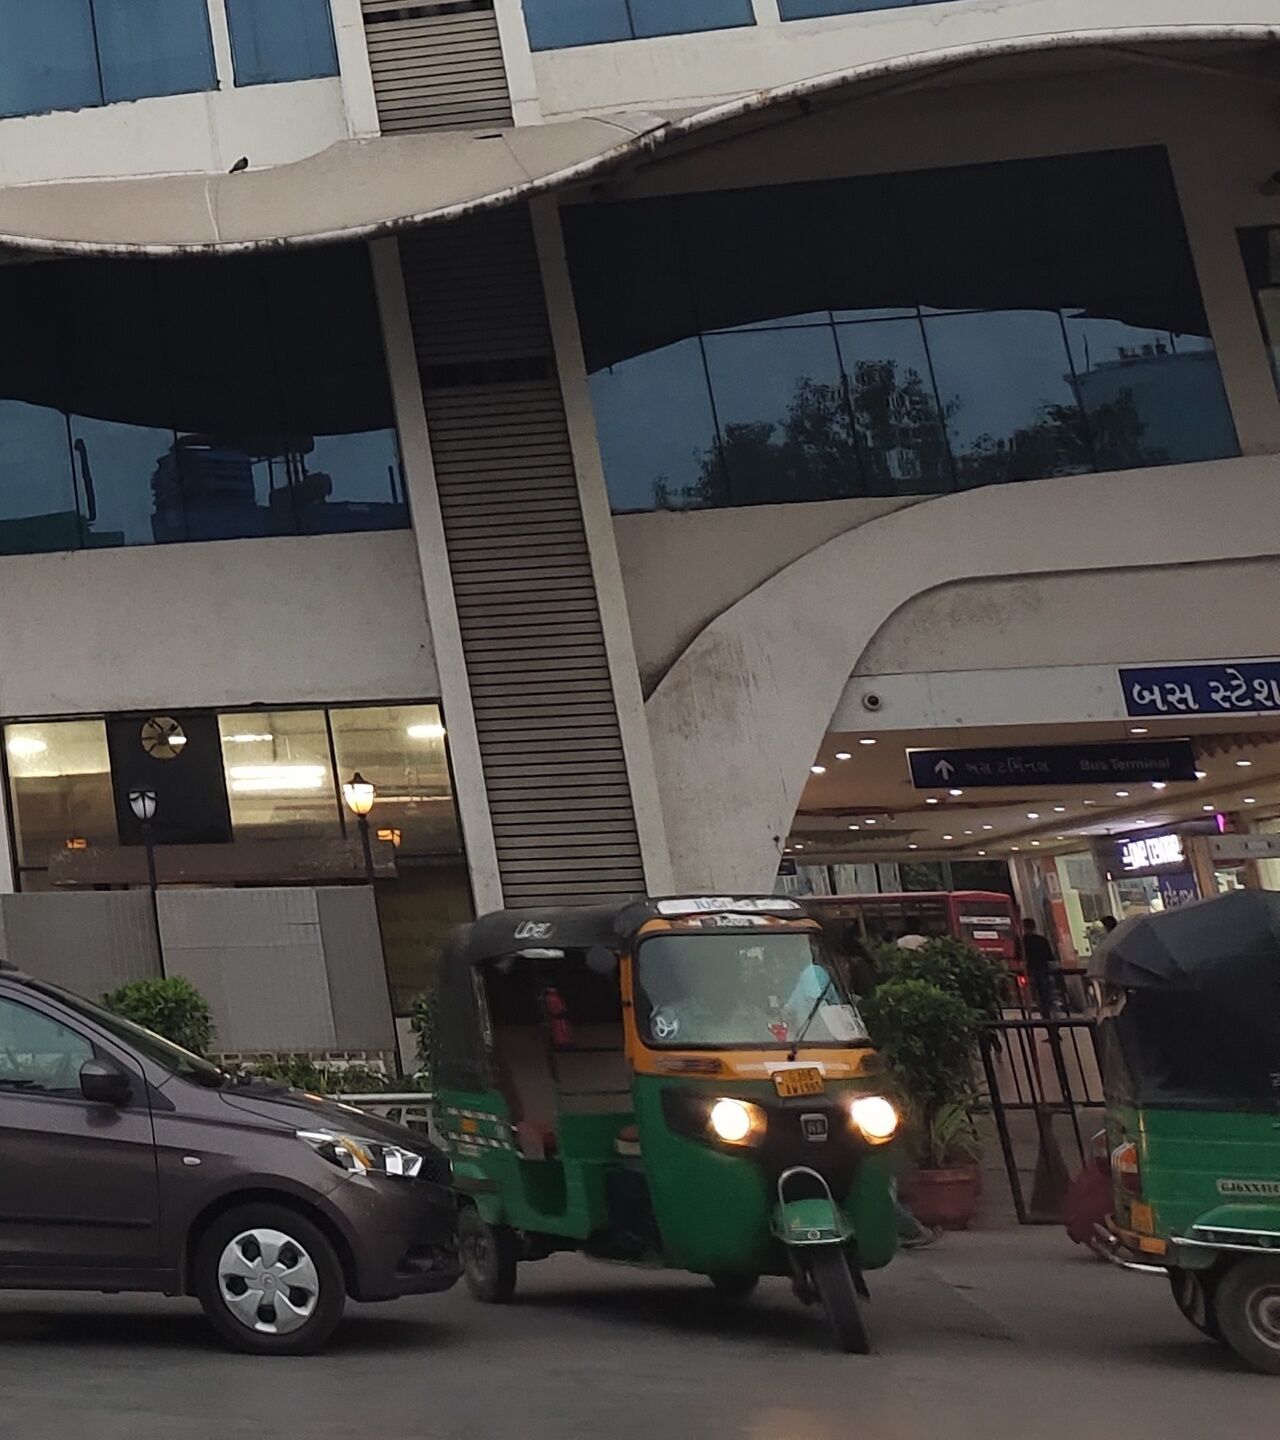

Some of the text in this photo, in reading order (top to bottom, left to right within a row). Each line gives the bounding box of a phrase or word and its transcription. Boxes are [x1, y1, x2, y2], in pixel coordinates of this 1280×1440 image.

[1132, 682, 1199, 711] બસ
[1080, 758, 1170, 771] Bus Terminal
